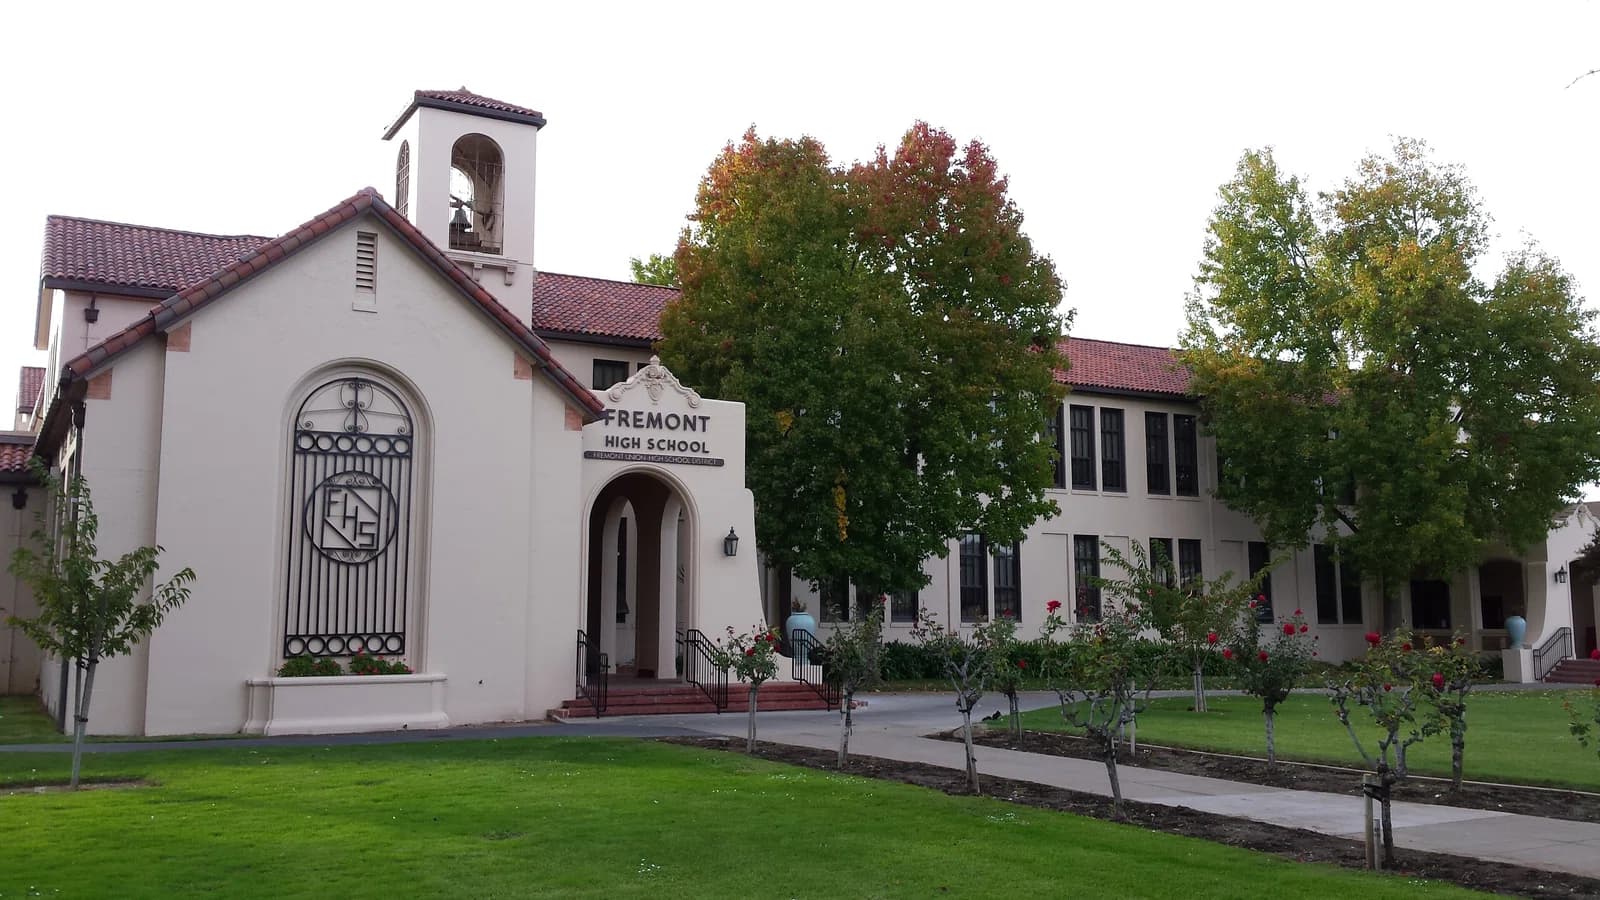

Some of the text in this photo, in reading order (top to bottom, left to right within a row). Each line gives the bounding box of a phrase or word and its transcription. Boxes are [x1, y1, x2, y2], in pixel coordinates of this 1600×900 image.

[603, 408, 711, 433] FREMONT
[605, 435, 710, 454] HIGH SCHOOL
[593, 452, 623, 460] FREMONT
[625, 453, 646, 461] UNION
[665, 456, 691, 464] SCHOOL
[692, 457, 718, 466] DISTRICT
